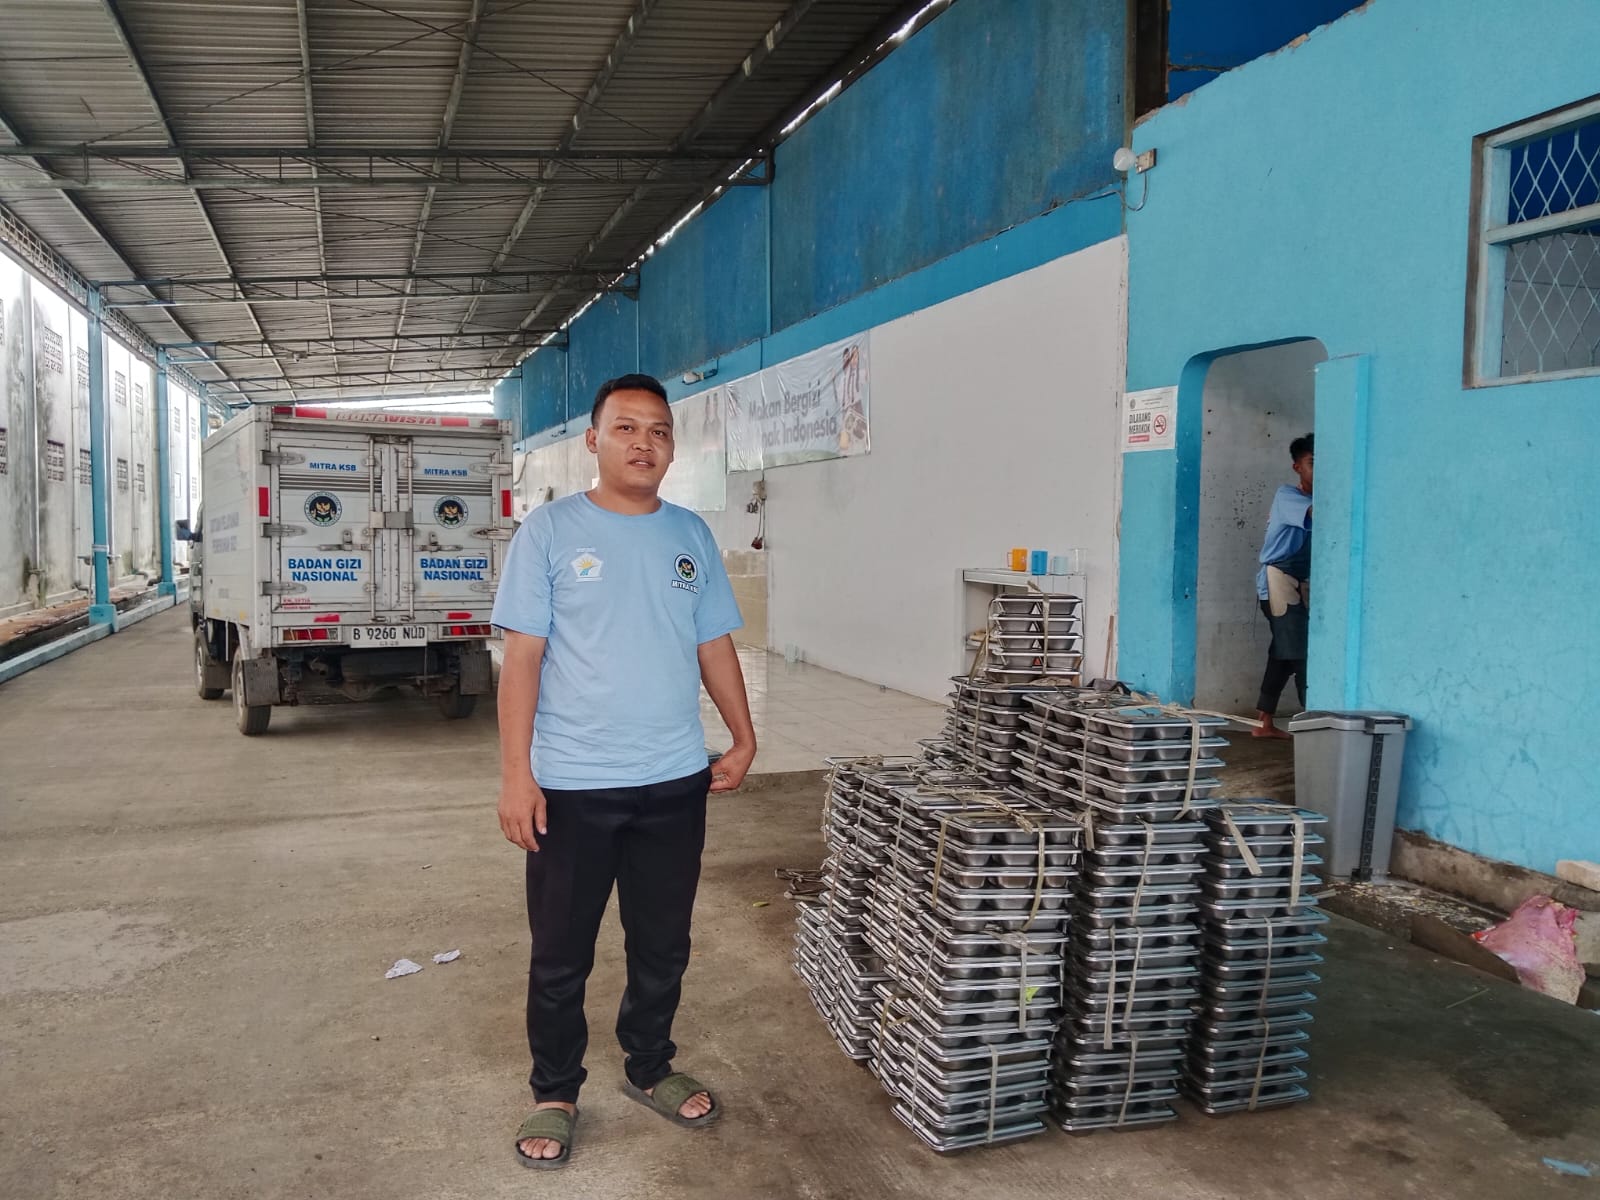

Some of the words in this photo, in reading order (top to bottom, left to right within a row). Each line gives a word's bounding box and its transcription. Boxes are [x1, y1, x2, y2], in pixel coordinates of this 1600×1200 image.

[783, 380, 821, 417] Bergizi
[783, 409, 838, 444] Indonesia
[309, 462, 337, 471] MITRA
[424, 468, 450, 476] MITRA
[451, 469, 468, 477] KSB
[288, 558, 332, 569] BADAN
[336, 558, 362, 569] GIZI
[420, 558, 460, 569] BADAN
[464, 558, 488, 569] GIZI
[292, 571, 358, 582] NASIONAL
[424, 570, 484, 581] NASIONAL
[353, 628, 361, 640] B
[367, 627, 397, 640] 9260
